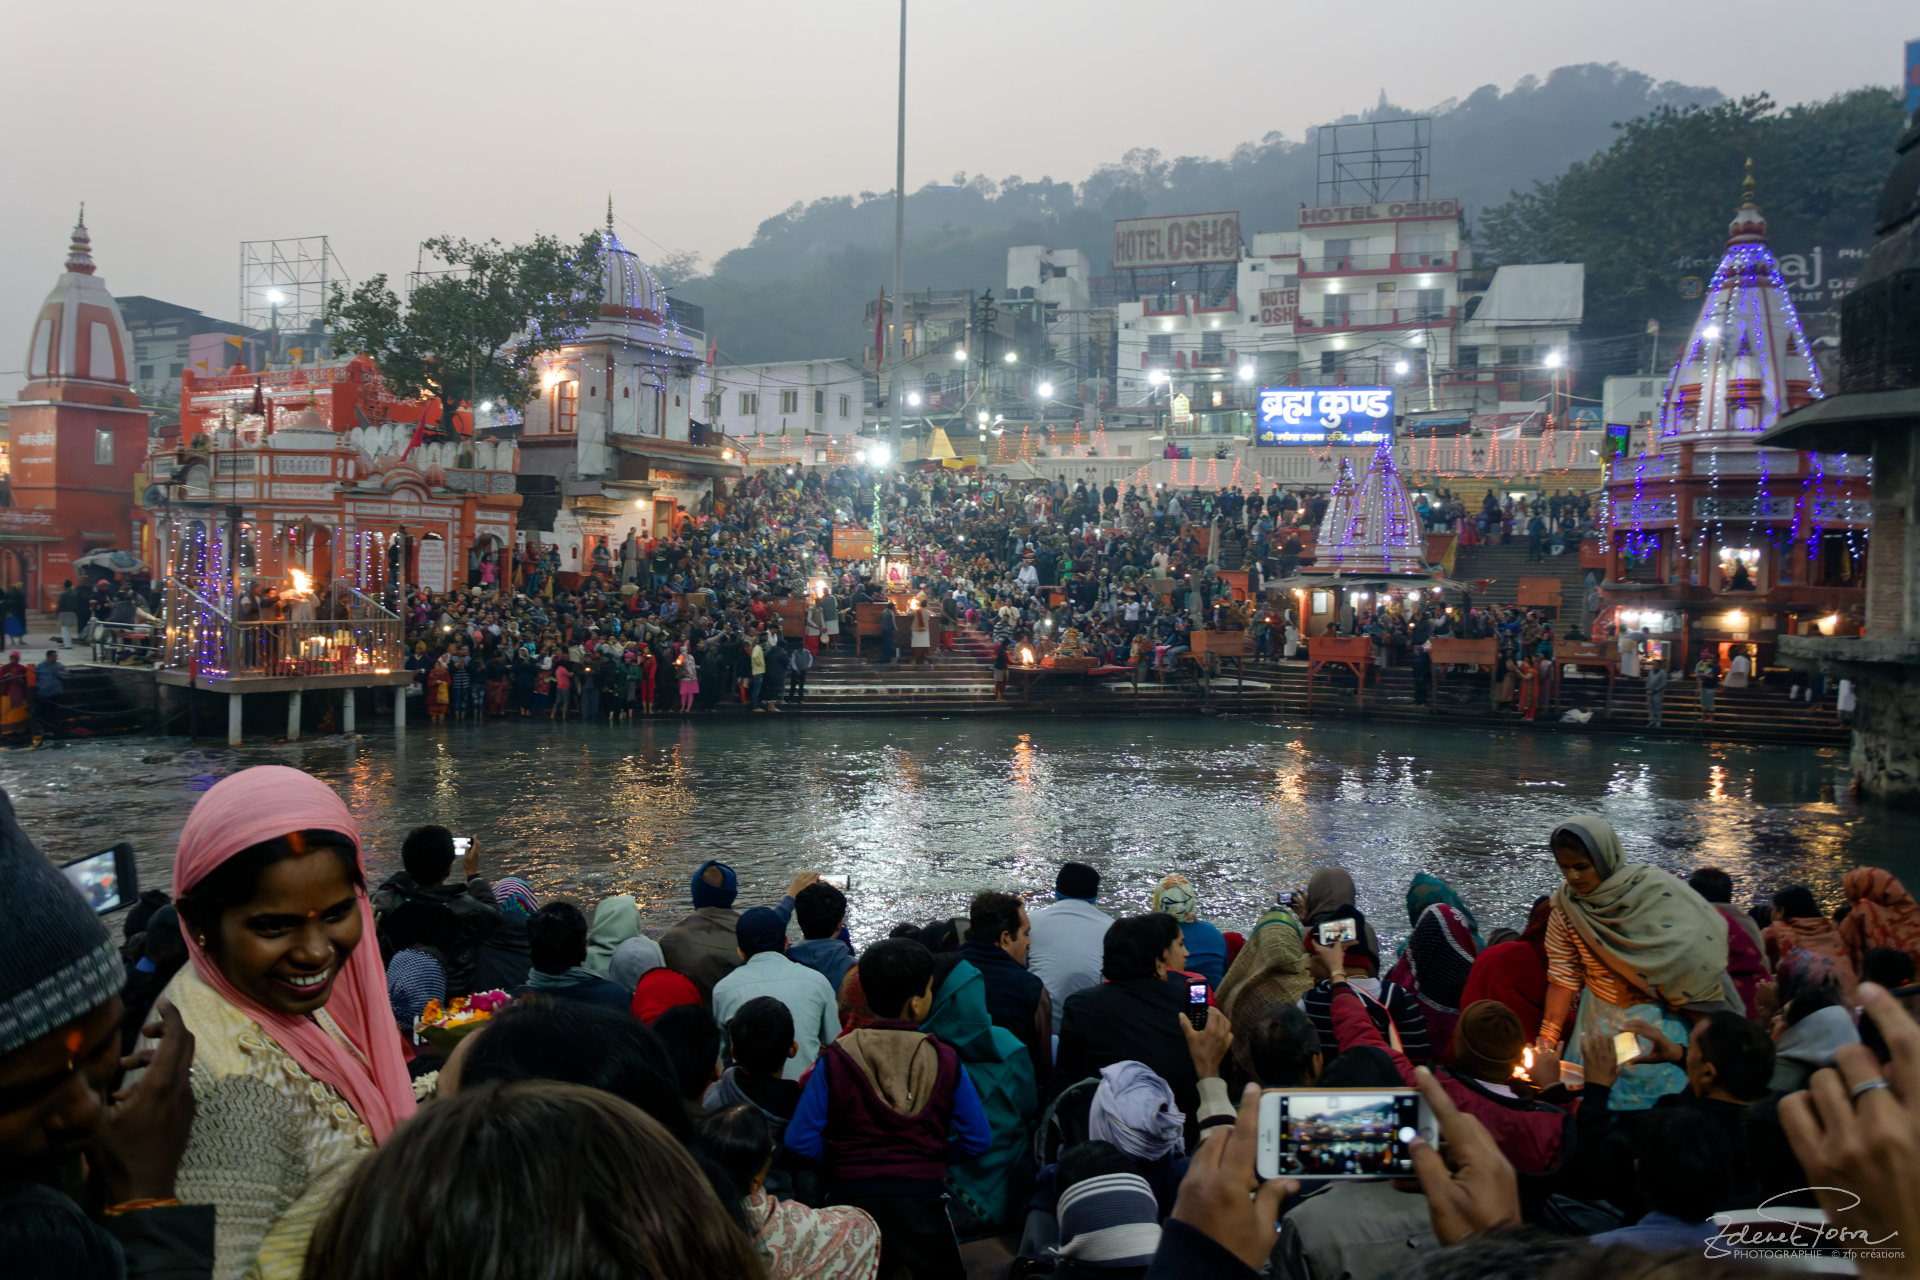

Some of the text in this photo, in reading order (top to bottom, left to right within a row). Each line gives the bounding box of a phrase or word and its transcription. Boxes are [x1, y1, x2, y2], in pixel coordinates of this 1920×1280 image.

[1301, 200, 1456, 224] HOTEL OSHO
[1115, 217, 1238, 263] HOTEL OSHO
[1260, 390, 1392, 429] ब्रह्म कुण्ड
[1260, 430, 1274, 442] श्री
[1275, 431, 1299, 442] गंगा
[1301, 432, 1325, 442] सभा
